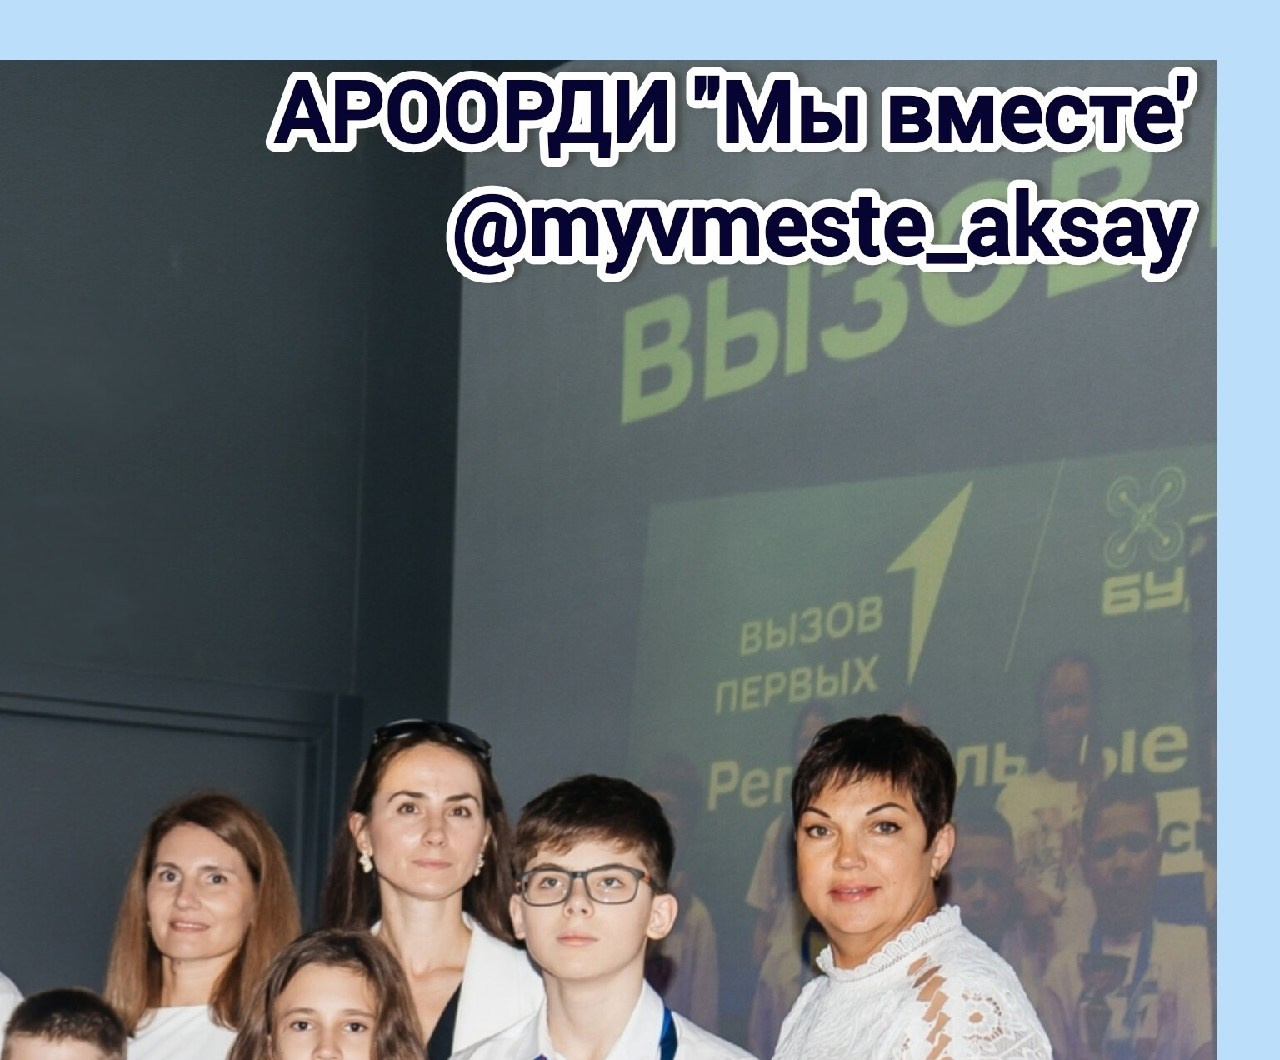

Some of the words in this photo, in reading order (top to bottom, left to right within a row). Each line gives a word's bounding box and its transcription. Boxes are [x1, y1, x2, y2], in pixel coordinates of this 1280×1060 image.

[1102, 567, 1190, 617] БУ
[740, 595, 884, 656] ВЫЗОВ
[715, 656, 879, 715] ПЕРВЫХ
